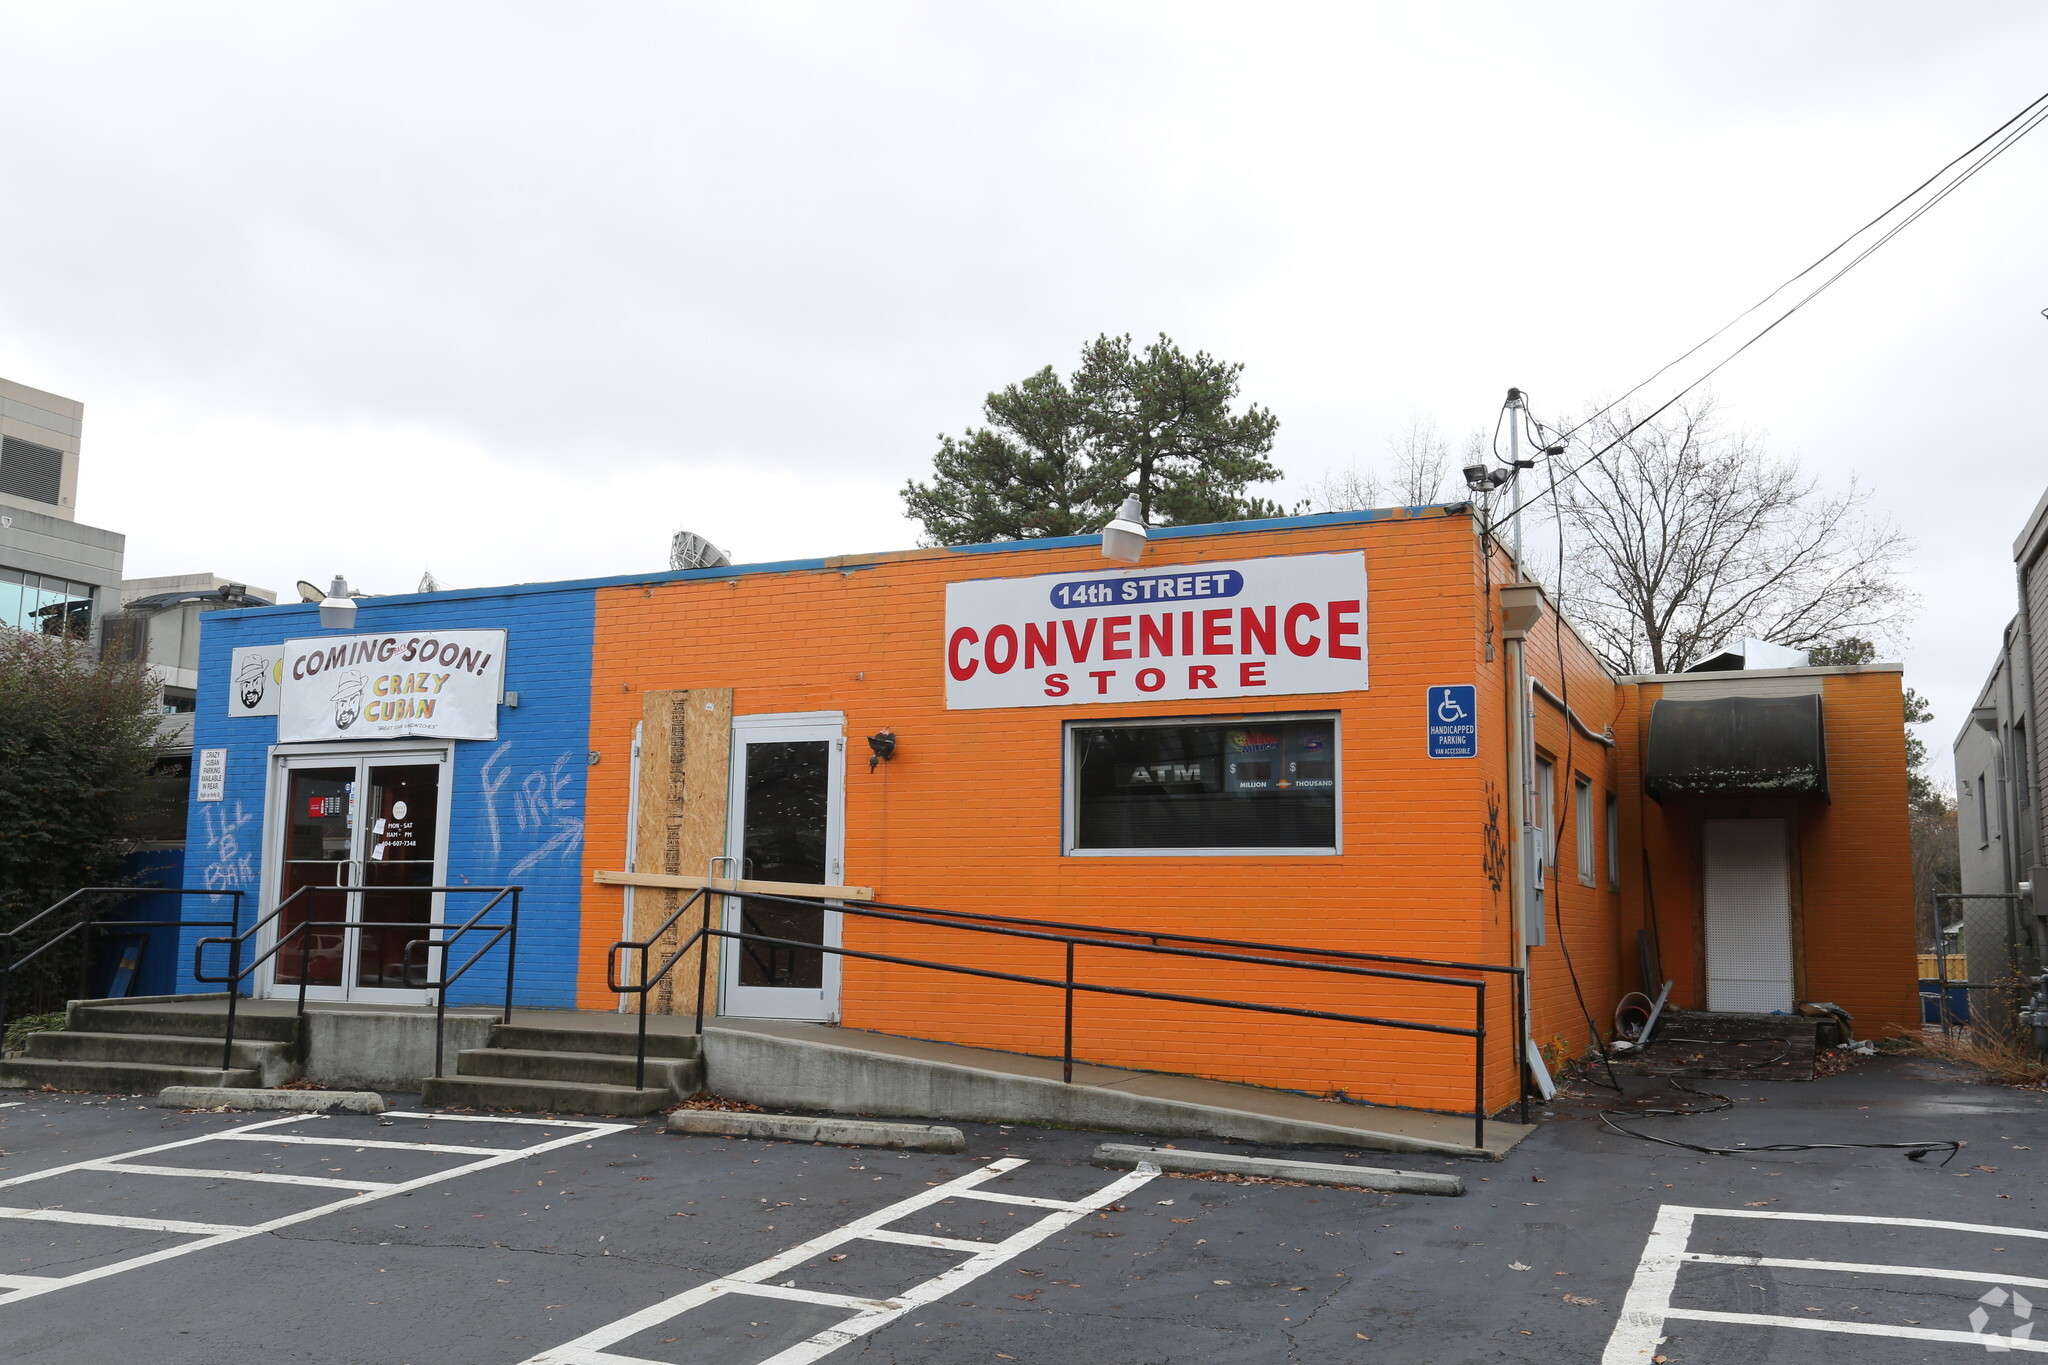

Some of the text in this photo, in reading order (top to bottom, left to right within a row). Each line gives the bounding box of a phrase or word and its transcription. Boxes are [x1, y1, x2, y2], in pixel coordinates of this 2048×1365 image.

[1057, 573, 1230, 605] 14th STREET
[948, 600, 1361, 682] CONVENIENCE
[292, 637, 397, 681] COMING
[402, 637, 492, 676] SOON!
[373, 672, 450, 697] CRAZY
[1043, 661, 1266, 697] STORE
[363, 698, 437, 722] CUBAN
[1430, 725, 1475, 735] HANDICAPPED
[1439, 735, 1466, 745] PARKING
[206, 751, 220, 759] CRAZY
[1444, 747, 1471, 755] ACCESSIBLE
[205, 759, 220, 767] CUBAN
[1229, 763, 1237, 774] $
[1289, 761, 1297, 772] $
[201, 774, 222, 782] AVAILABLE
[1129, 763, 1201, 783] ATM
